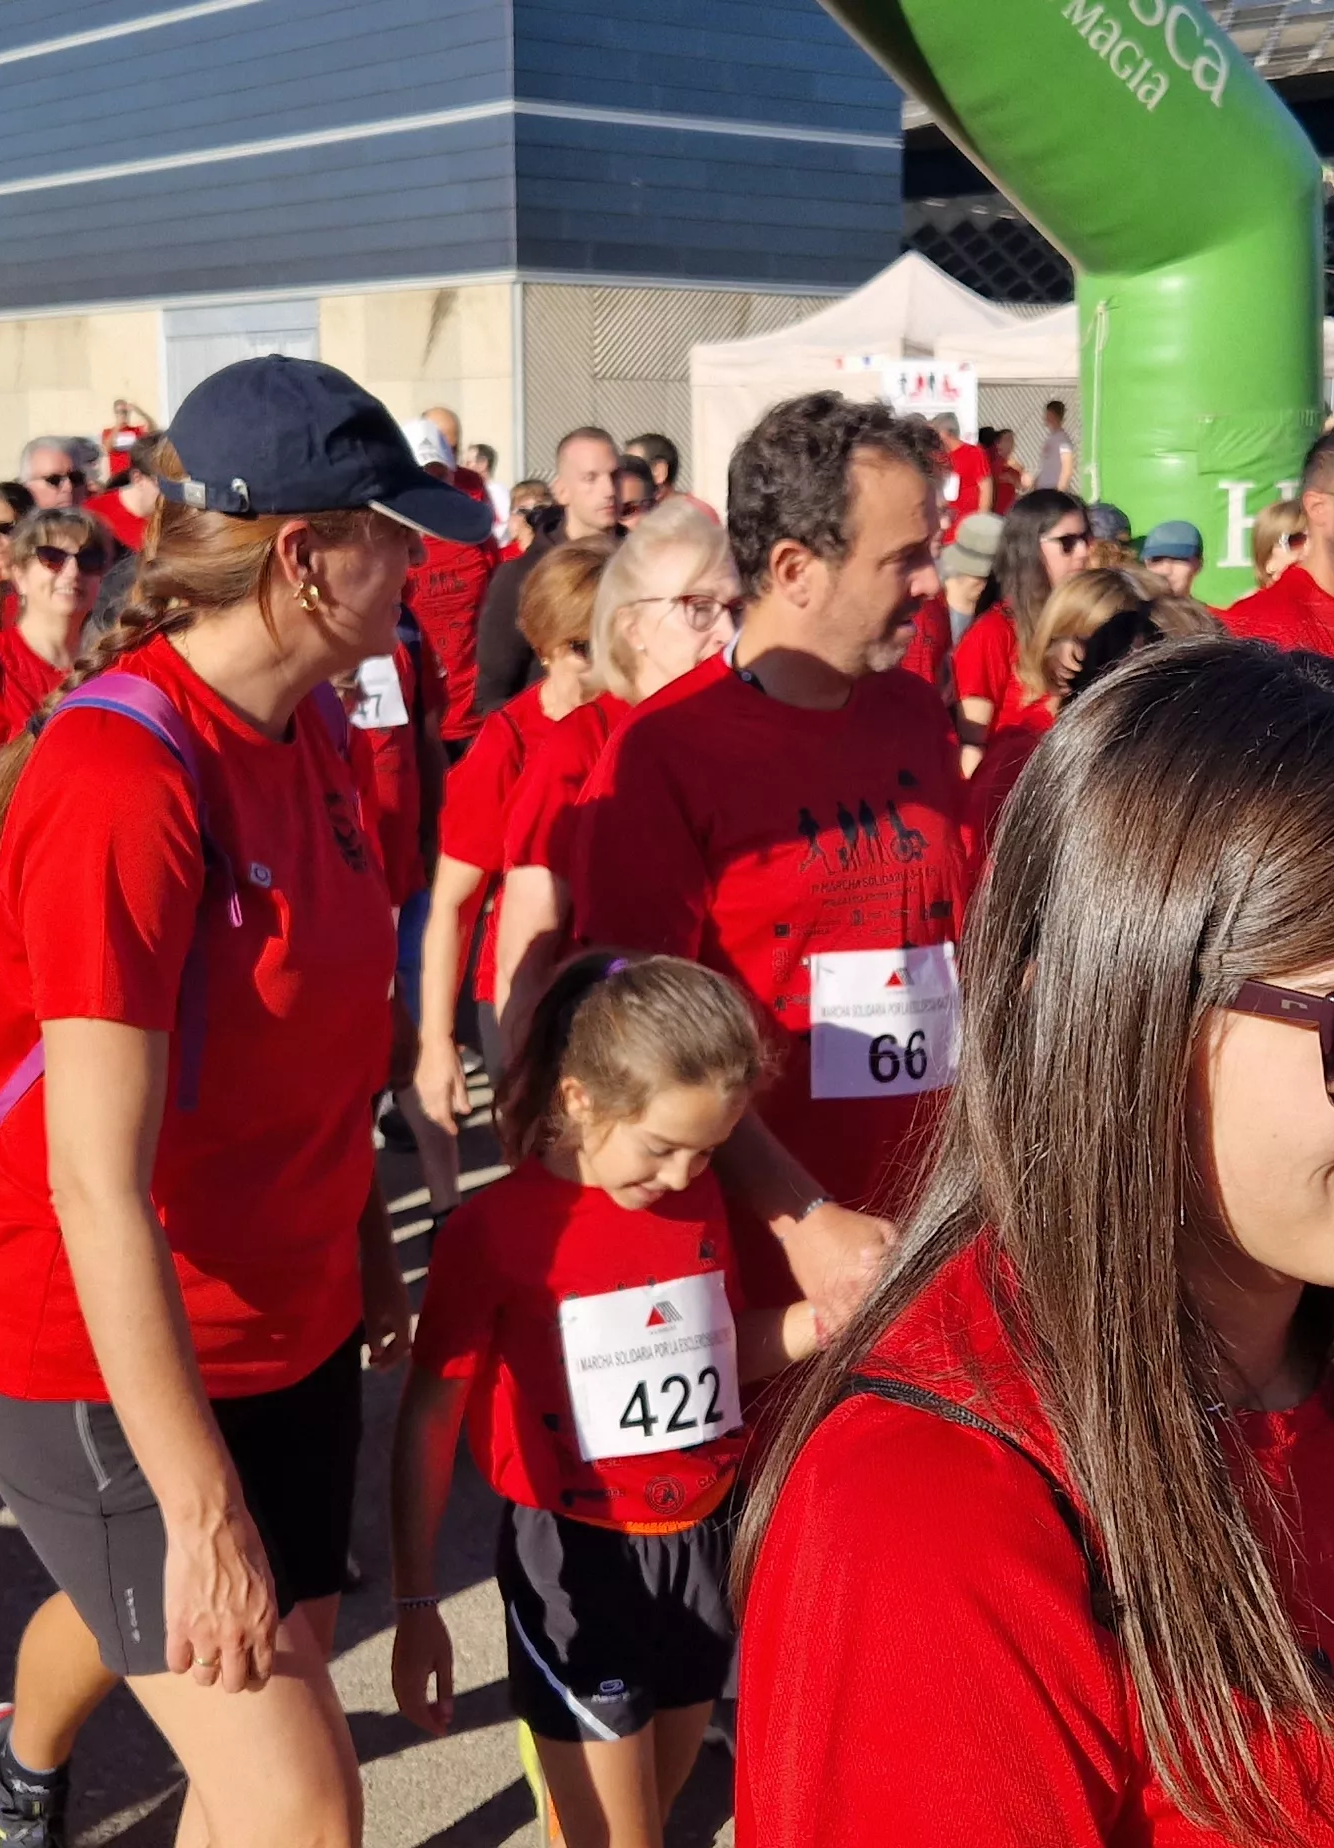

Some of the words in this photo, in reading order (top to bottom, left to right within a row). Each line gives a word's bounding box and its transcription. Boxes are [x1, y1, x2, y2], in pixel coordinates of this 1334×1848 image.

[869, 1030, 927, 1083] 66
[579, 1354, 613, 1373] MARCHA
[614, 1345, 654, 1367] SOLIDARIA
[619, 1365, 724, 1437] 422
